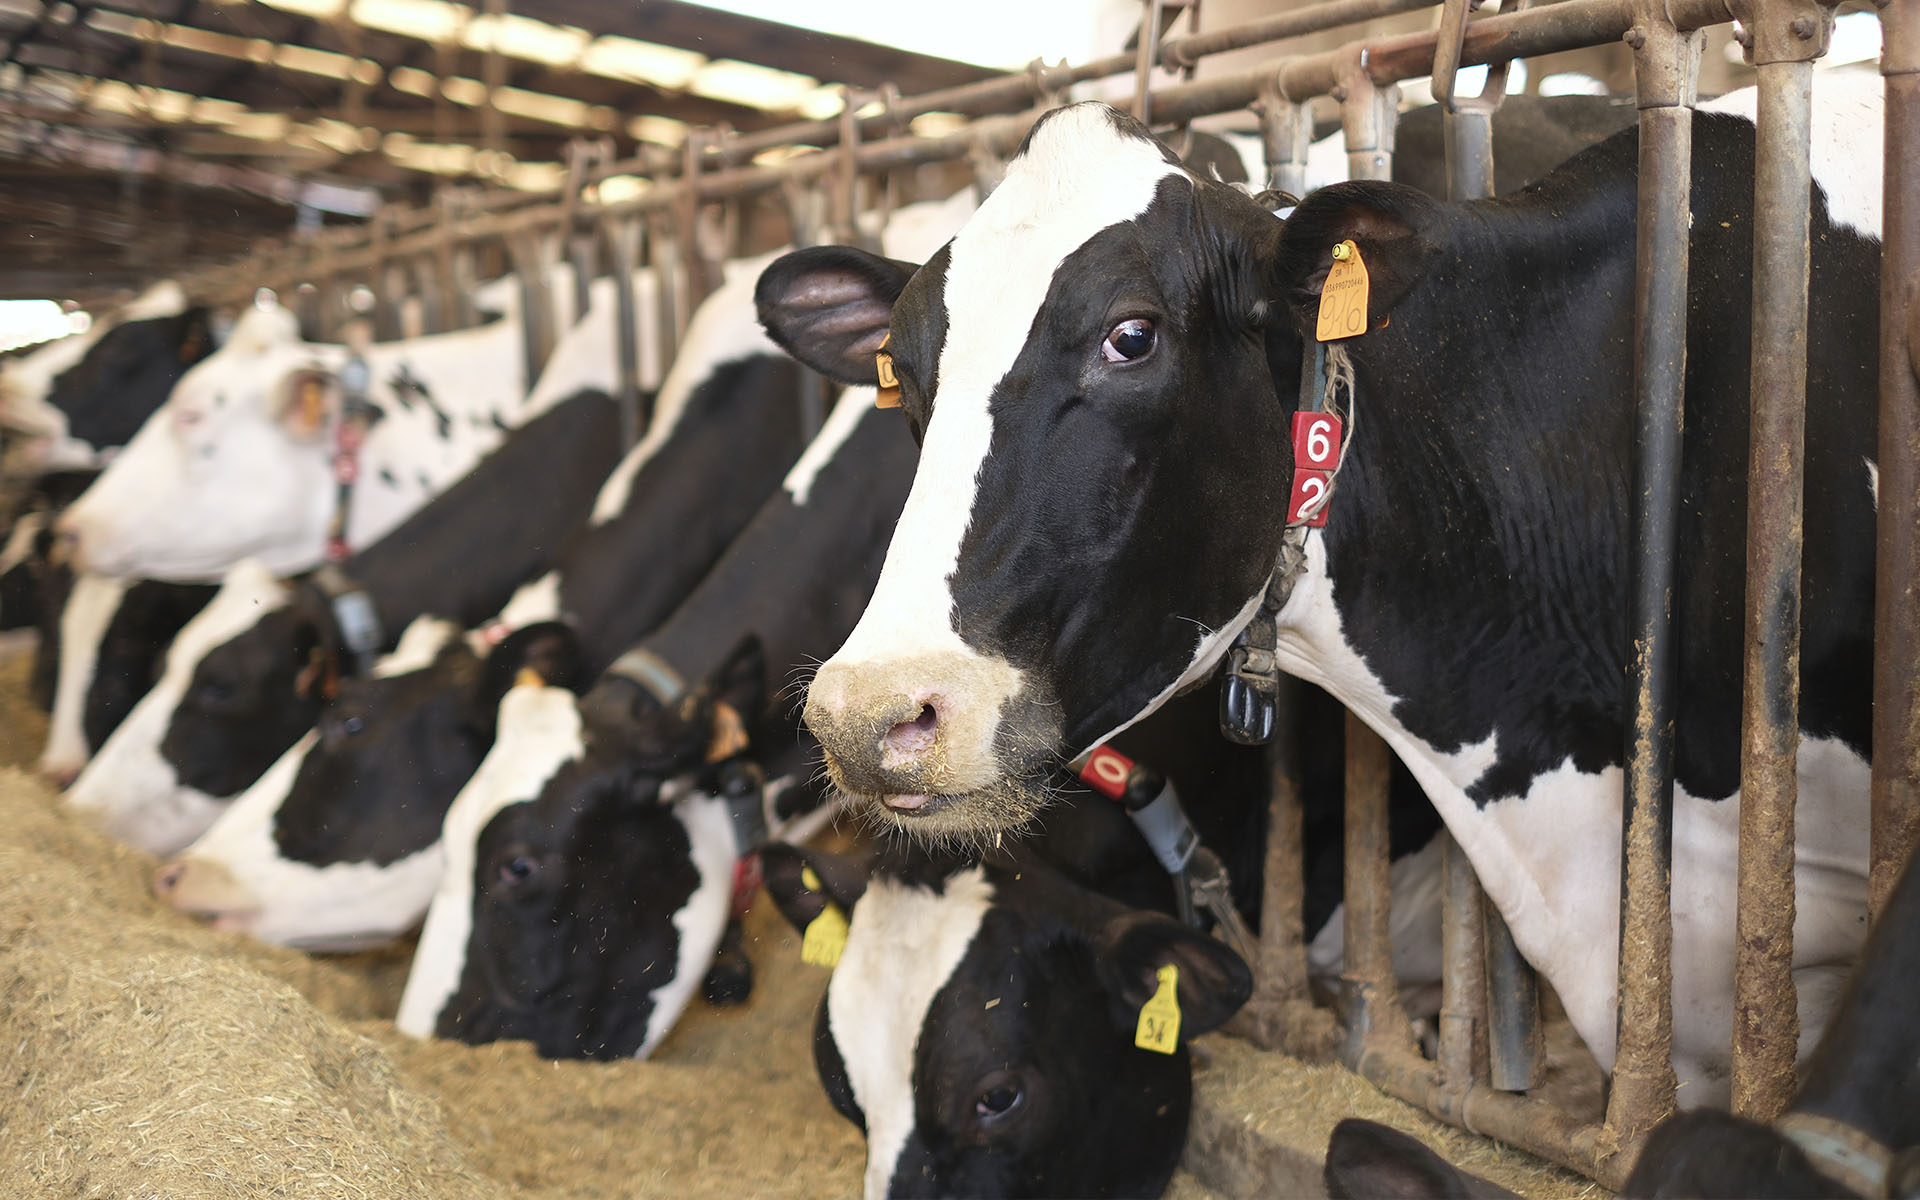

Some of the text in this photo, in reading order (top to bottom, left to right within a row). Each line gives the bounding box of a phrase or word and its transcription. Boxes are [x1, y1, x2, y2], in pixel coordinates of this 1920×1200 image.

[1320, 289, 1362, 337] 916
[1307, 420, 1331, 462] 6
[1296, 477, 1325, 520] 2
[1093, 755, 1129, 783] 0
